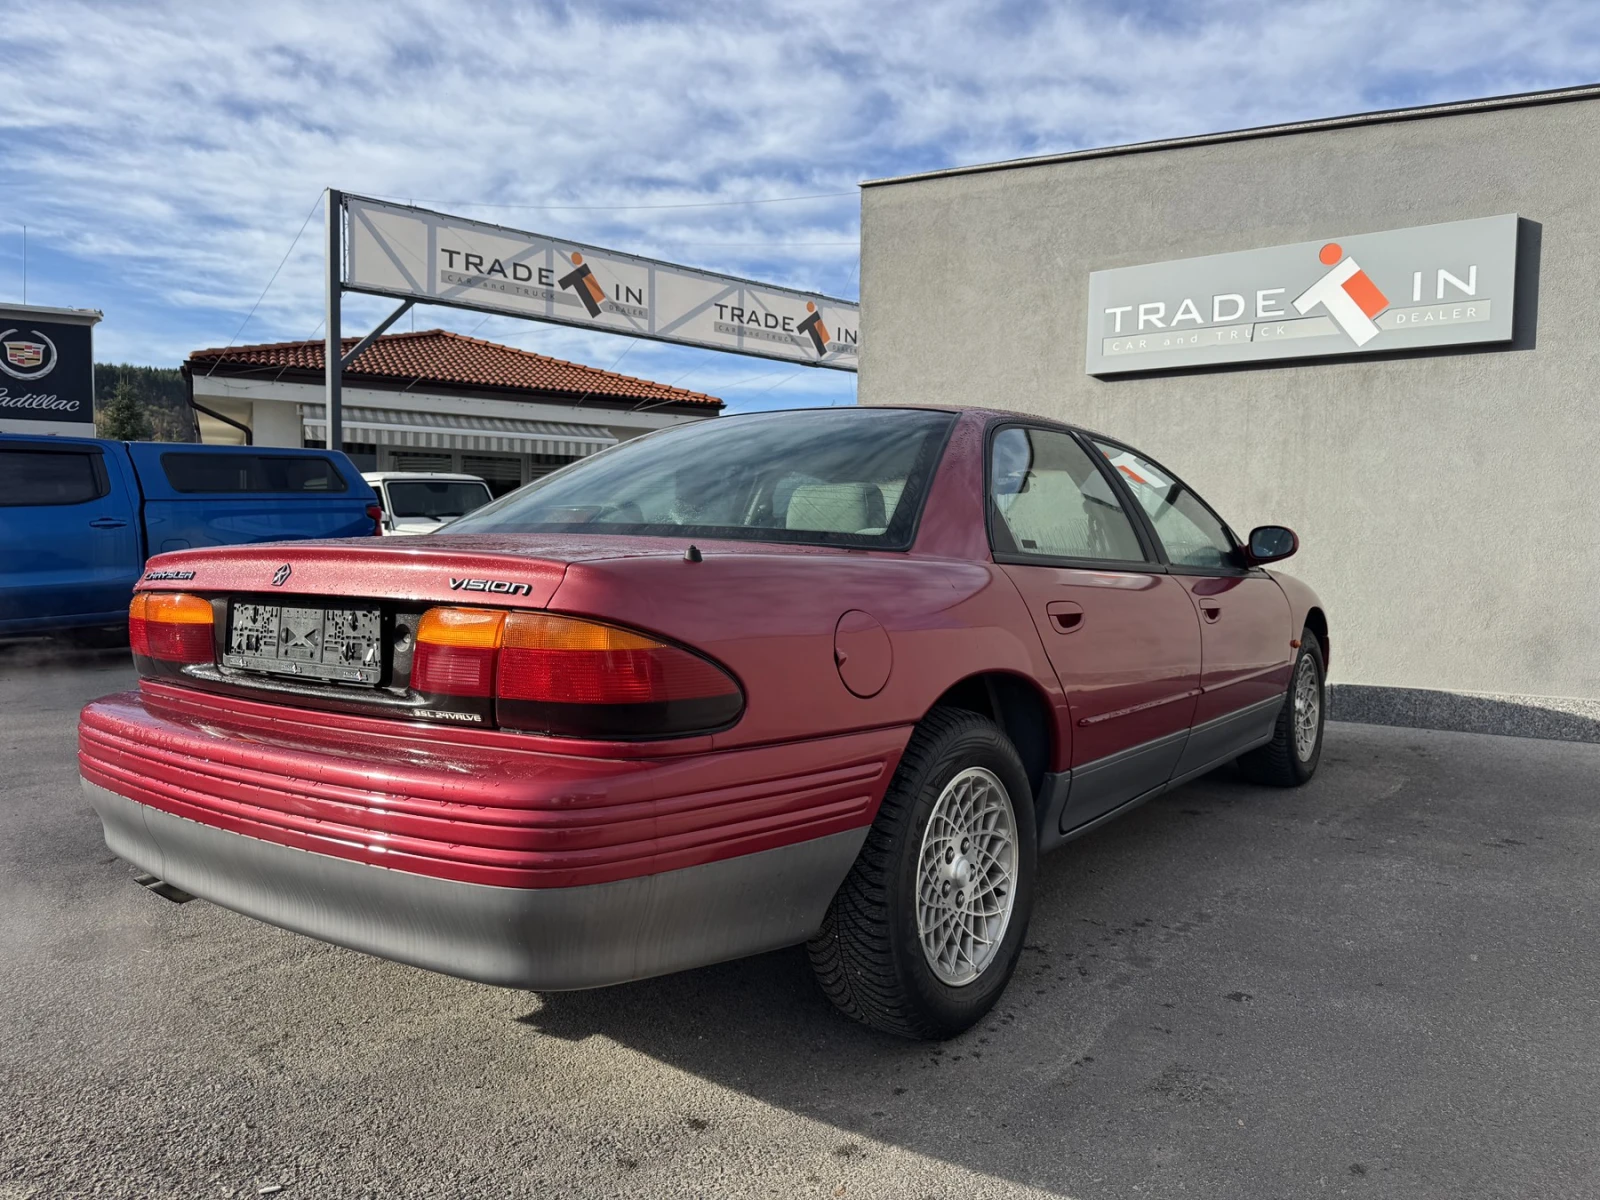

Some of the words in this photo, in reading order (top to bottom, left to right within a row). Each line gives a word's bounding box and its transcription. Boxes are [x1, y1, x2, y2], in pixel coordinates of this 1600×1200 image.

[441, 248, 555, 287] TRADE
[615, 283, 643, 306] IN
[447, 274, 473, 285] CAR
[482, 281, 505, 292] and
[516, 286, 556, 300] TRUCK
[609, 304, 644, 316] DEALER
[1104, 288, 1285, 333] TRADE
[1412, 265, 1477, 301] IN
[714, 303, 795, 333] TRADE
[837, 327, 857, 345] IN
[1112, 339, 1147, 351] CAR
[1164, 334, 1198, 346] and
[1216, 325, 1285, 341] TRUCK
[1396, 307, 1476, 324] DEALER
[145, 571, 196, 581] CHRYSLER
[448, 577, 532, 596] VISION
